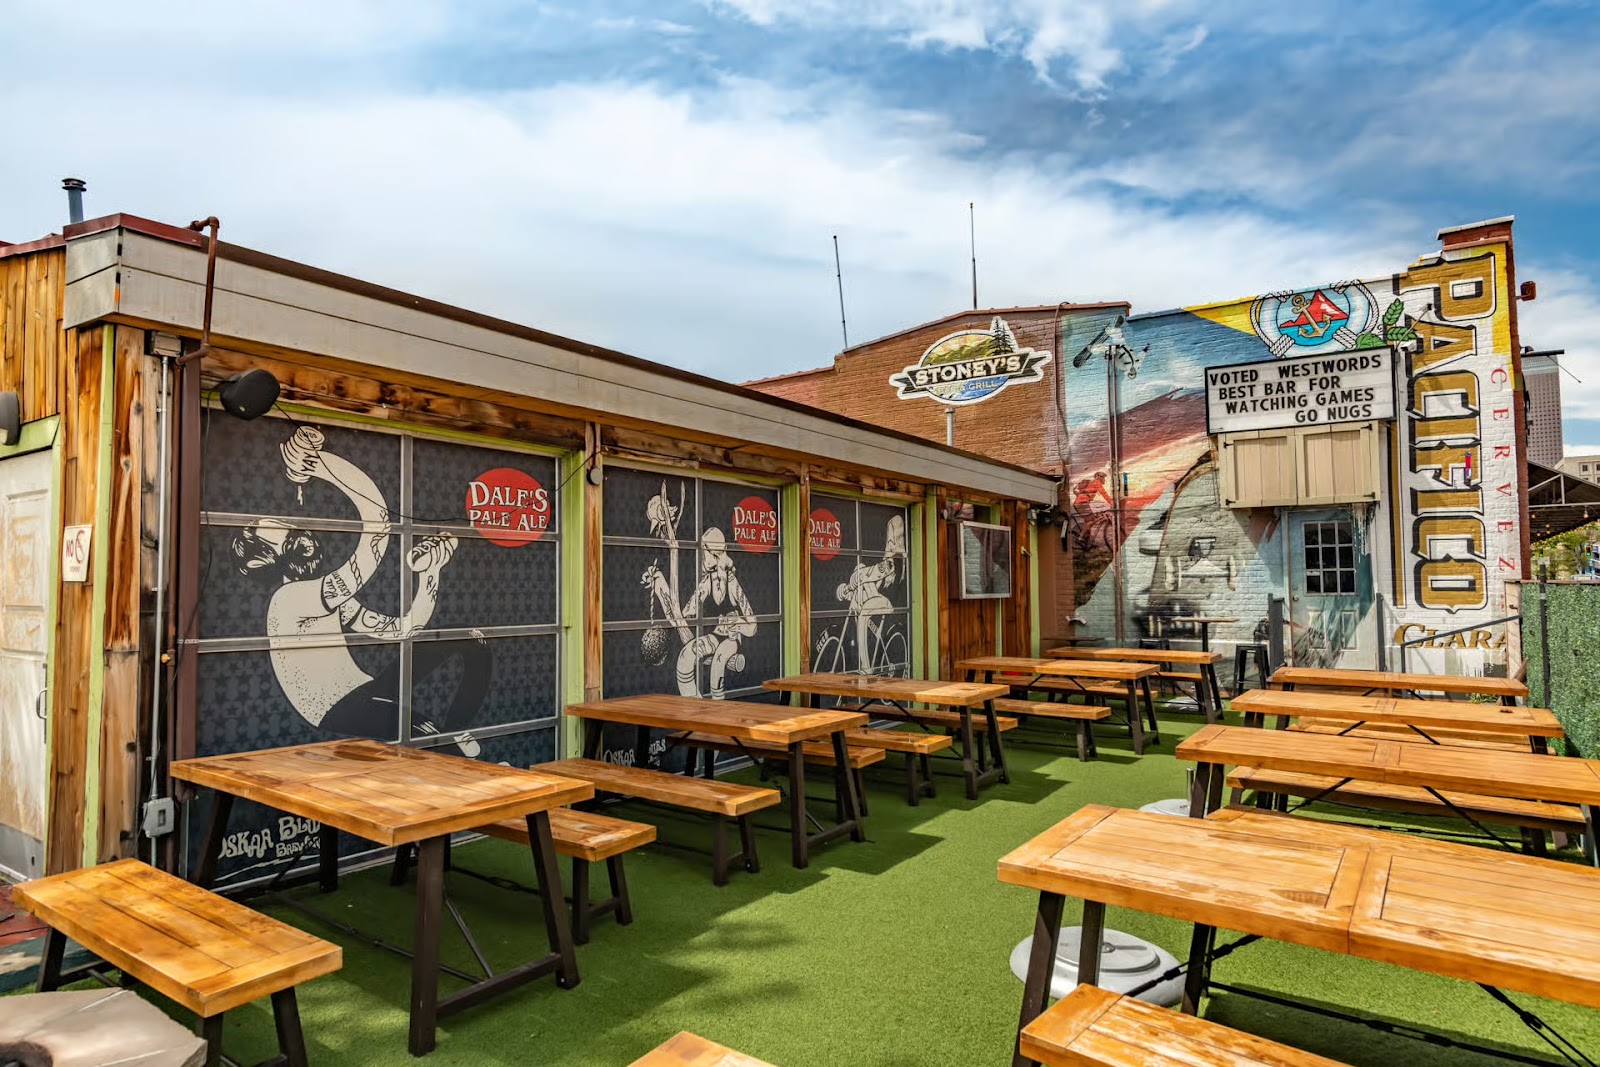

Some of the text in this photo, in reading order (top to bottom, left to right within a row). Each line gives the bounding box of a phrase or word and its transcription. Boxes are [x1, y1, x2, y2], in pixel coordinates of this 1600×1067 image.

[915, 355, 1021, 386] STONEY'S
[1209, 354, 1382, 387] VOTED WESTWORDS
[969, 380, 997, 390] GRILL
[1219, 375, 1341, 400] BEST BAR FOR
[1226, 387, 1374, 415] WATCHING GAMES
[1295, 404, 1372, 423] GO NUGS
[1393, 252, 1496, 614] PACIFICO
[300, 452, 321, 472] YAY
[468, 481, 548, 512] DALE'S
[1491, 368, 1516, 609] CERVEZ
[469, 509, 547, 531] PALE ALE
[733, 506, 777, 529] DALE'S
[734, 527, 776, 543] PALE ALE
[827, 538, 841, 549] ALE
[278, 815, 321, 841] BLU
